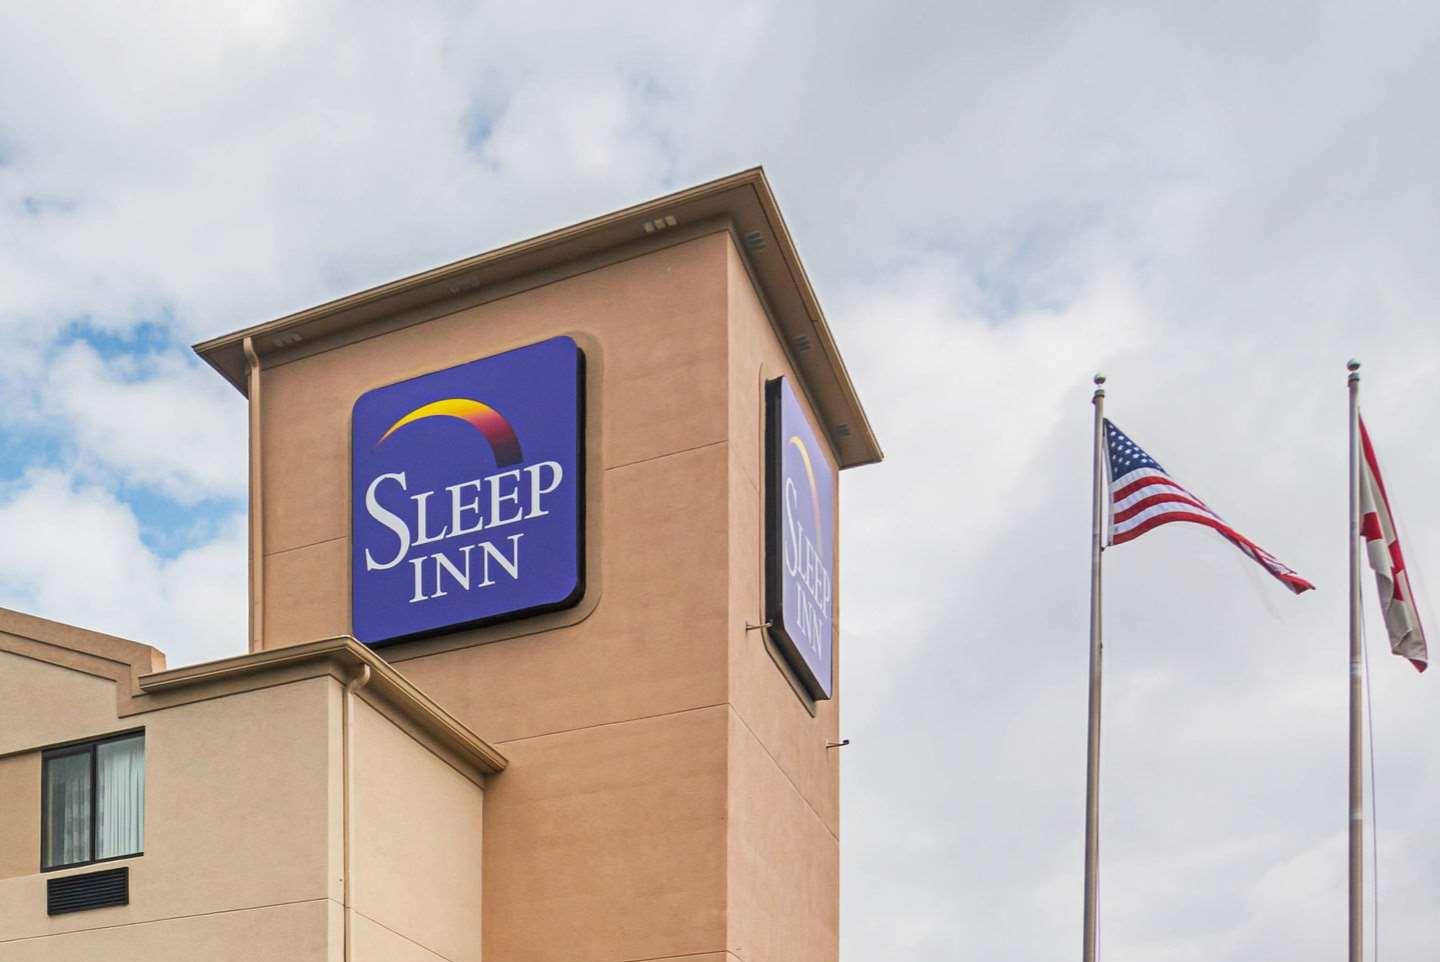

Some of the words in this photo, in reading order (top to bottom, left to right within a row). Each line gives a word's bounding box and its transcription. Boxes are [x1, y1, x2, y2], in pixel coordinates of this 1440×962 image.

[365, 461, 563, 571] SLEEP
[785, 477, 831, 618] SLEEP
[409, 533, 524, 603] INN
[796, 582, 823, 660] INN
